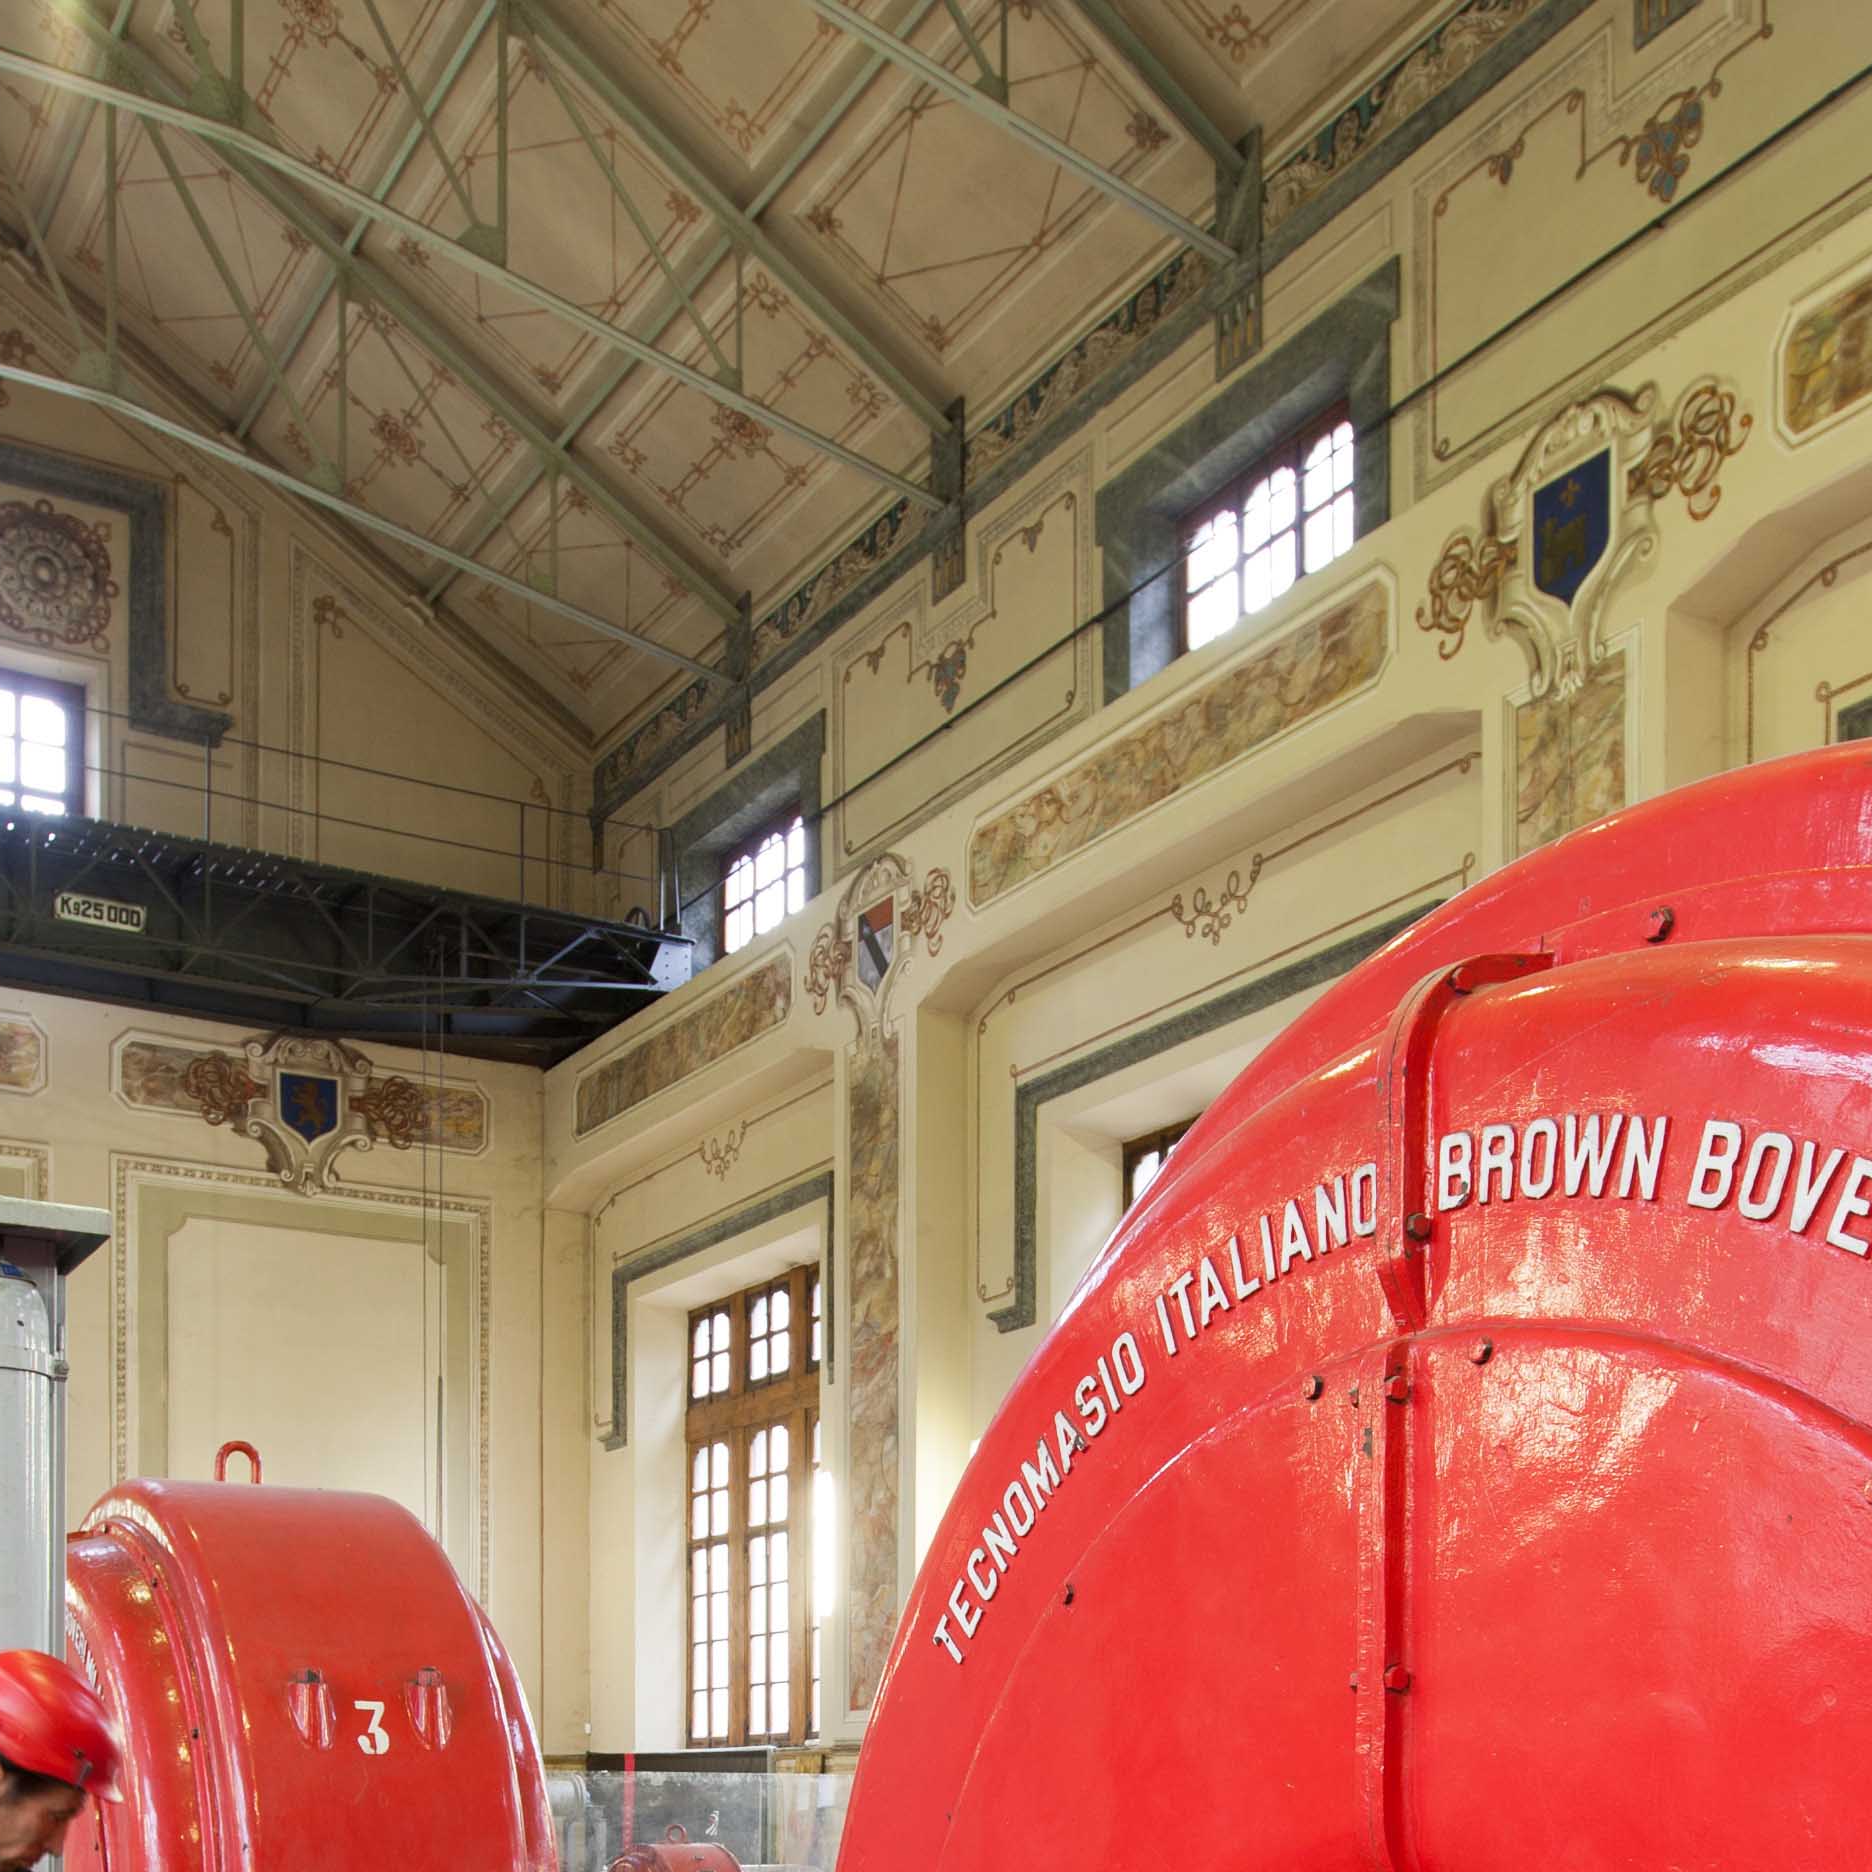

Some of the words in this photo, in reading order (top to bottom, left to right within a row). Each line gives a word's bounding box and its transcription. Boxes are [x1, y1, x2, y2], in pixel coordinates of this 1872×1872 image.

[931, 1332, 1146, 1666] TECNOMASIO
[1155, 1162, 1378, 1355] ITALIANO
[1438, 1113, 1667, 1212] BROWN
[354, 1700, 390, 1755] 3
